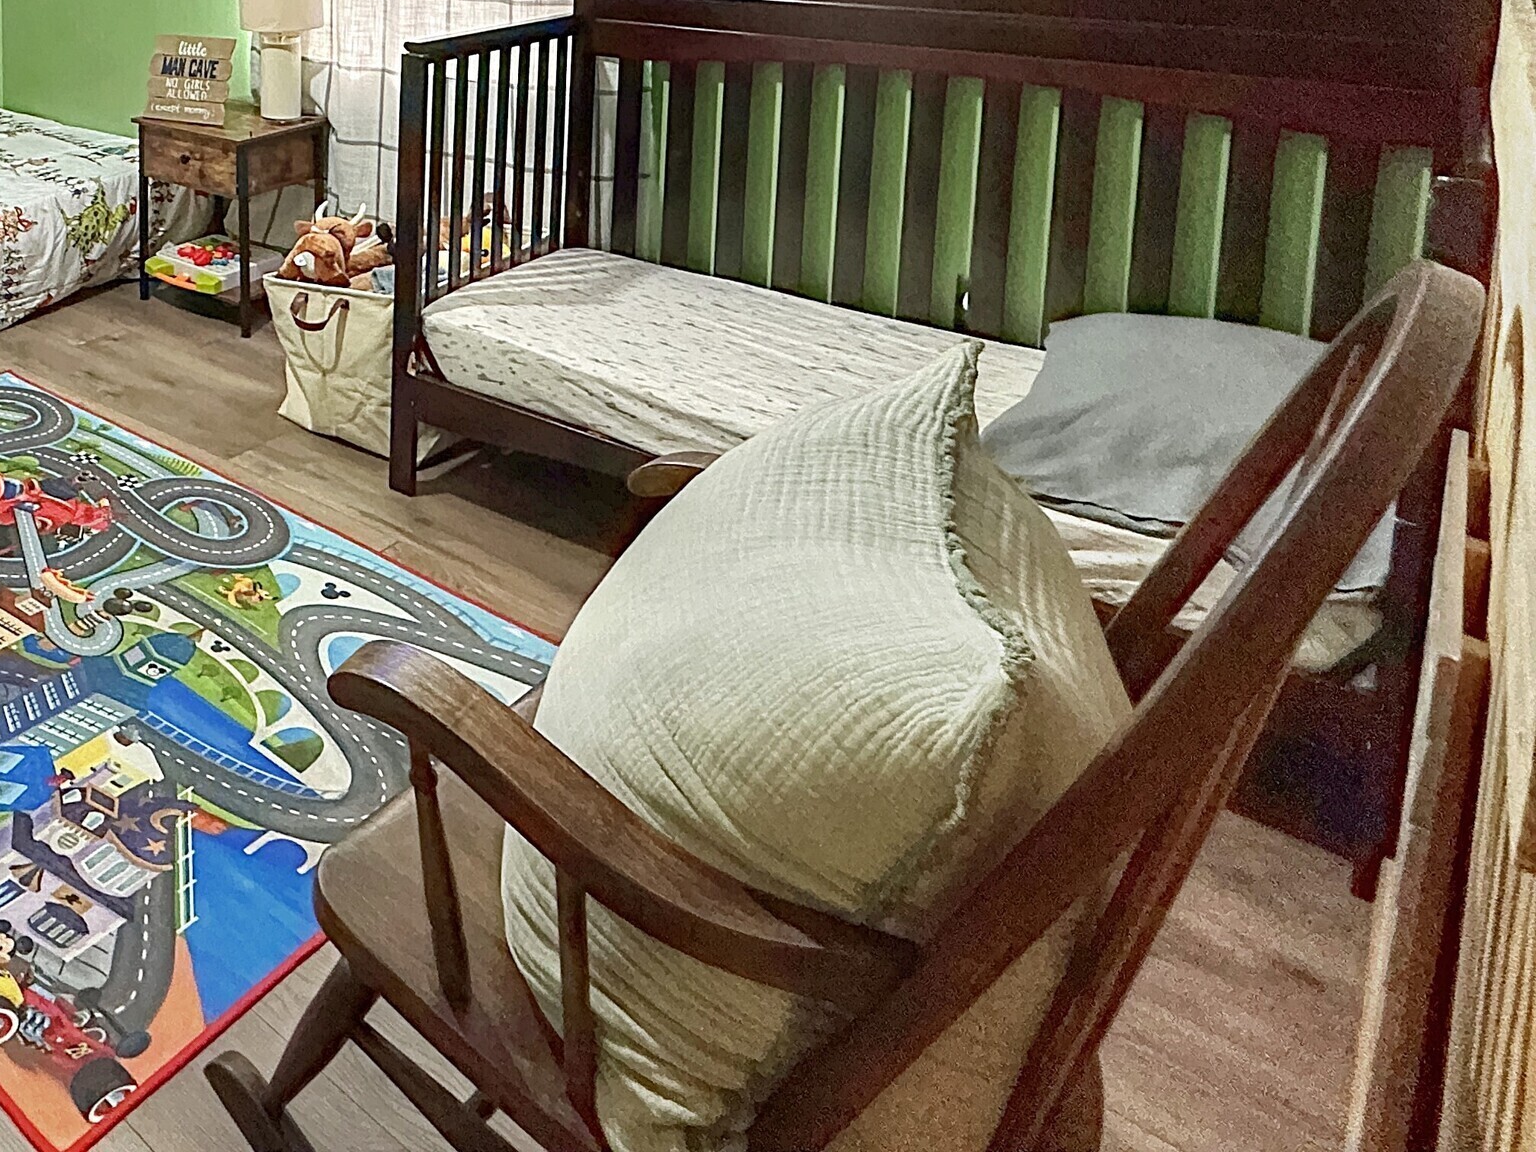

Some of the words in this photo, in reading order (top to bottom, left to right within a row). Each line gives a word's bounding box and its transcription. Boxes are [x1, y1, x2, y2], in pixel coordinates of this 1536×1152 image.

[161, 56, 186, 76] MAN
[188, 59, 219, 79] CAVE
[166, 77, 179, 88] NO
[184, 79, 211, 91] GIRLS
[166, 88, 208, 101] ALLOWED
